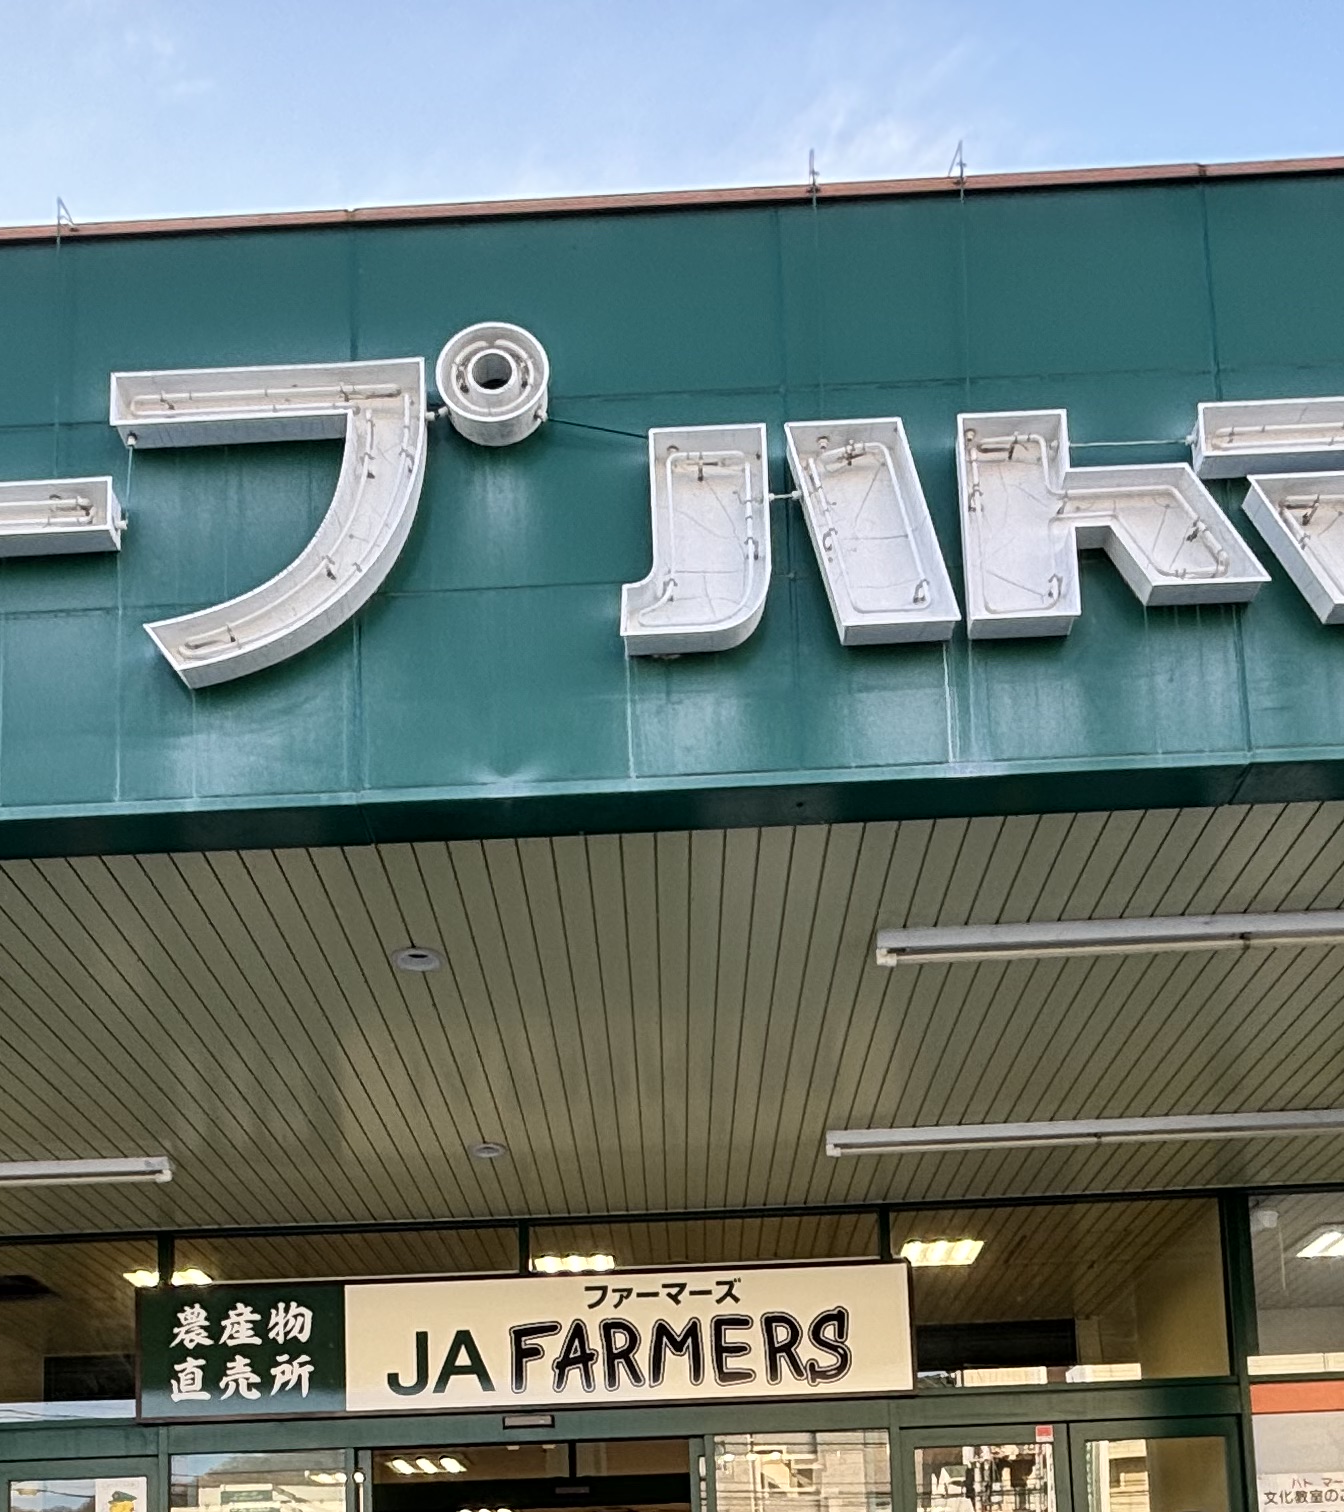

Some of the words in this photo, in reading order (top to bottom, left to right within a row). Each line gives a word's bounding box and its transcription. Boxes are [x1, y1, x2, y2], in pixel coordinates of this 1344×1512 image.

[584, 1277, 742, 1308] ファーマーズ
[169, 1301, 315, 1350] 農産物
[387, 1329, 496, 1396] JA
[509, 1305, 854, 1395] FARMERS
[169, 1354, 315, 1403] 直売所
